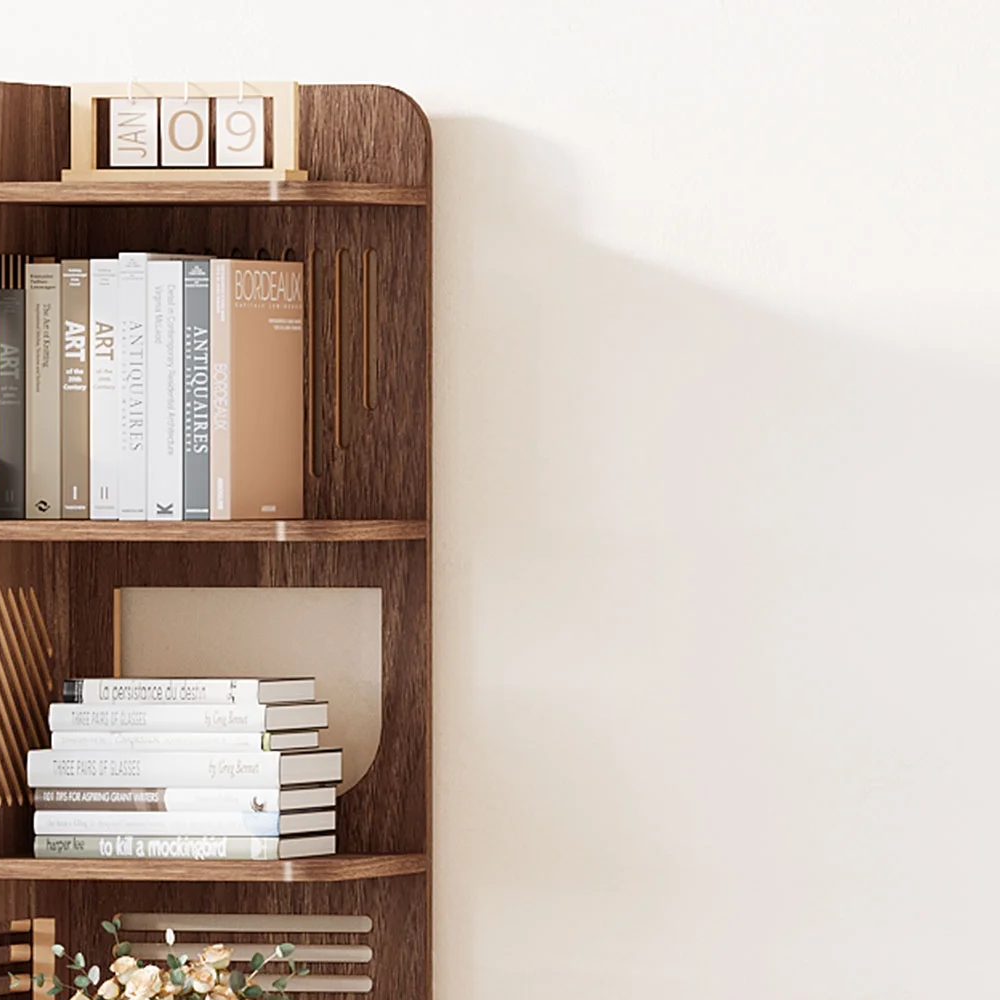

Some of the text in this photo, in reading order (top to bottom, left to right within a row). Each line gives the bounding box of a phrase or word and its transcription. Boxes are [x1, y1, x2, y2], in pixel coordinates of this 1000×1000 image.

[117, 112, 148, 159] JAN
[235, 269, 303, 302] BORDEAUX
[0, 343, 19, 379] ART
[65, 320, 86, 363] ART
[95, 321, 114, 361] ART
[127, 320, 144, 452] ANTIQUAIRES
[190, 326, 208, 453] ANTIQUAIRES
[214, 363, 227, 431] BORDEAUX
[157, 503, 174, 515] K
[53, 760, 74, 776] THREE
[77, 760, 97, 776] PAIRS
[111, 760, 140, 776] GLASSES
[99, 836, 227, 860] to kill a mockingbird
